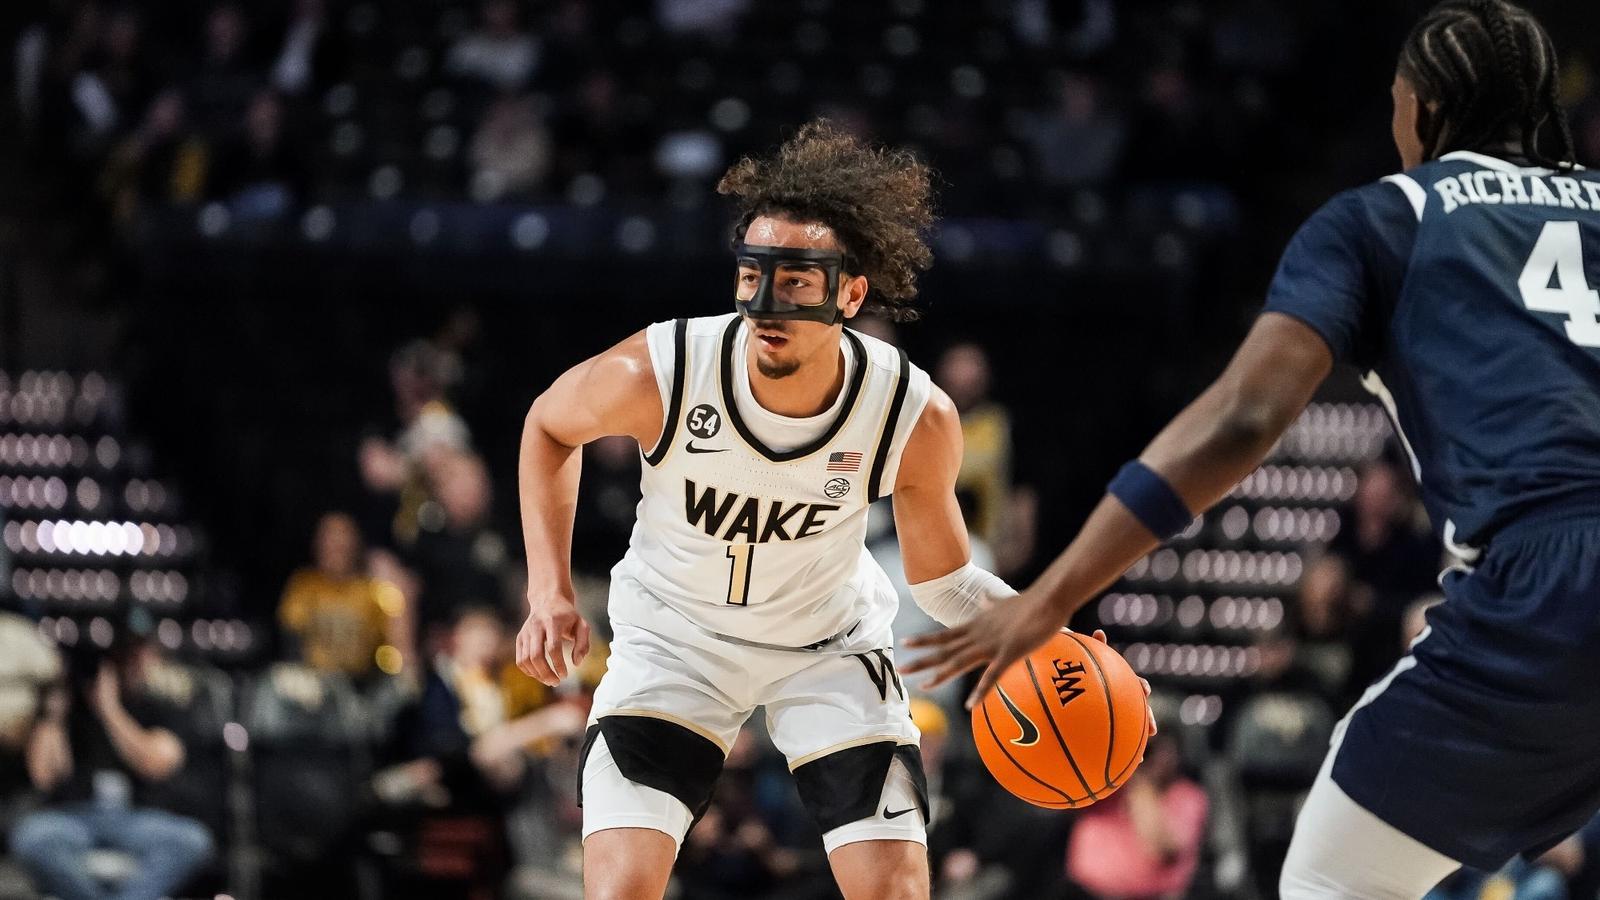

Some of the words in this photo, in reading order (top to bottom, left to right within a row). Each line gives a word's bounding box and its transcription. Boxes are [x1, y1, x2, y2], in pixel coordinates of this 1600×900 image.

[1518, 220, 1600, 347] 4
[689, 407, 719, 436] 54
[684, 477, 841, 544] WAKE
[726, 544, 755, 606] 1
[1051, 658, 1087, 707] WF
